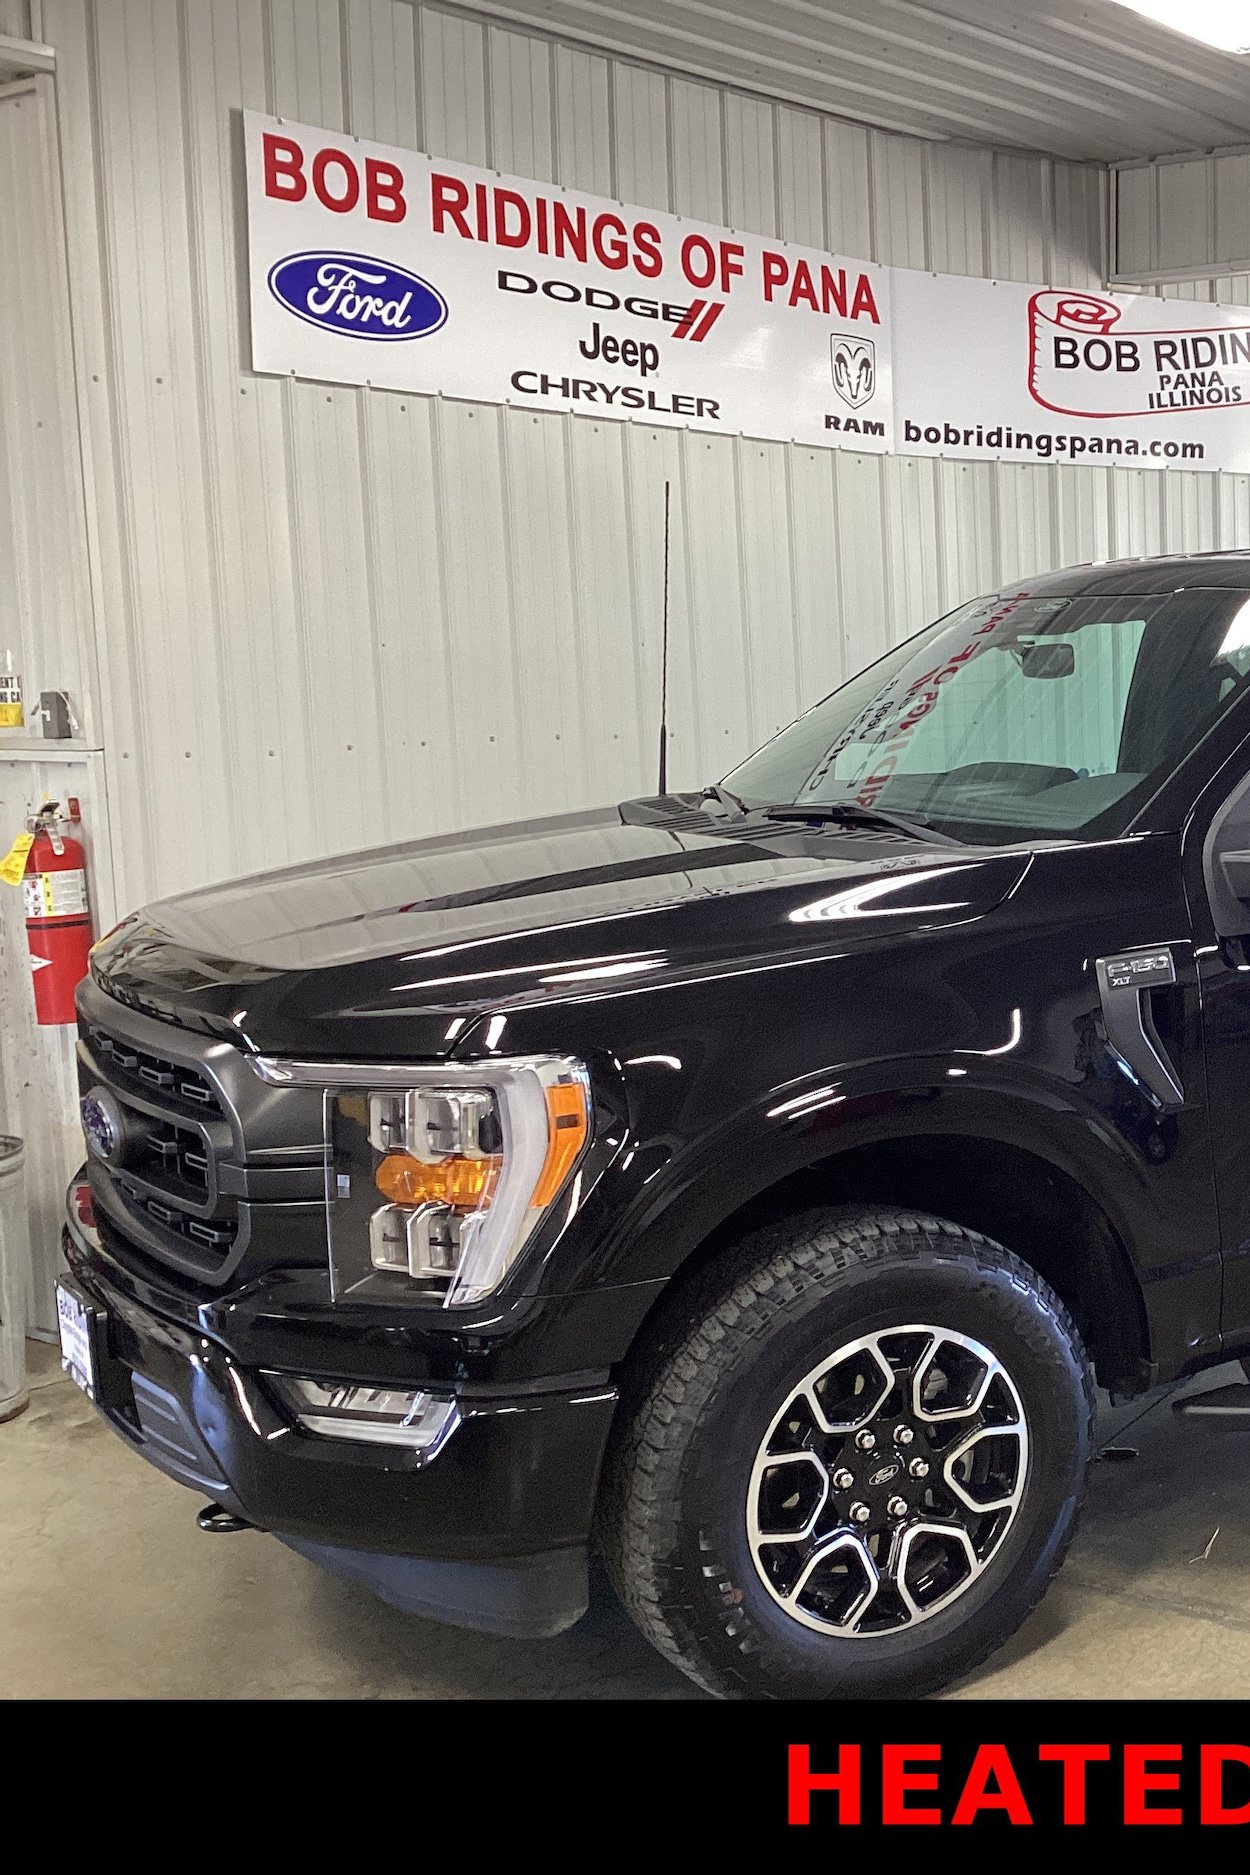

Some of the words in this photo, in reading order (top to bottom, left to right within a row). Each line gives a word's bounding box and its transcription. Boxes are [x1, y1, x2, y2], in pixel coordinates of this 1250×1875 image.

[263, 133, 407, 224] BOB
[431, 173, 663, 279] RIDINGS
[680, 235, 745, 293] OF
[762, 252, 881, 325] PANA
[306, 262, 415, 330] Ford
[497, 269, 694, 326] DODGE
[578, 321, 661, 377] Jeep
[1053, 335, 1141, 372] BOB
[509, 369, 721, 420] CHRYSLER
[1147, 385, 1243, 409] ILLINOIS
[1159, 370, 1225, 391] PANA
[824, 413, 886, 438] RAM
[904, 419, 1206, 461] bobridingspana.com
[1107, 954, 1169, 978] F-150
[1111, 975, 1131, 987] XLT
